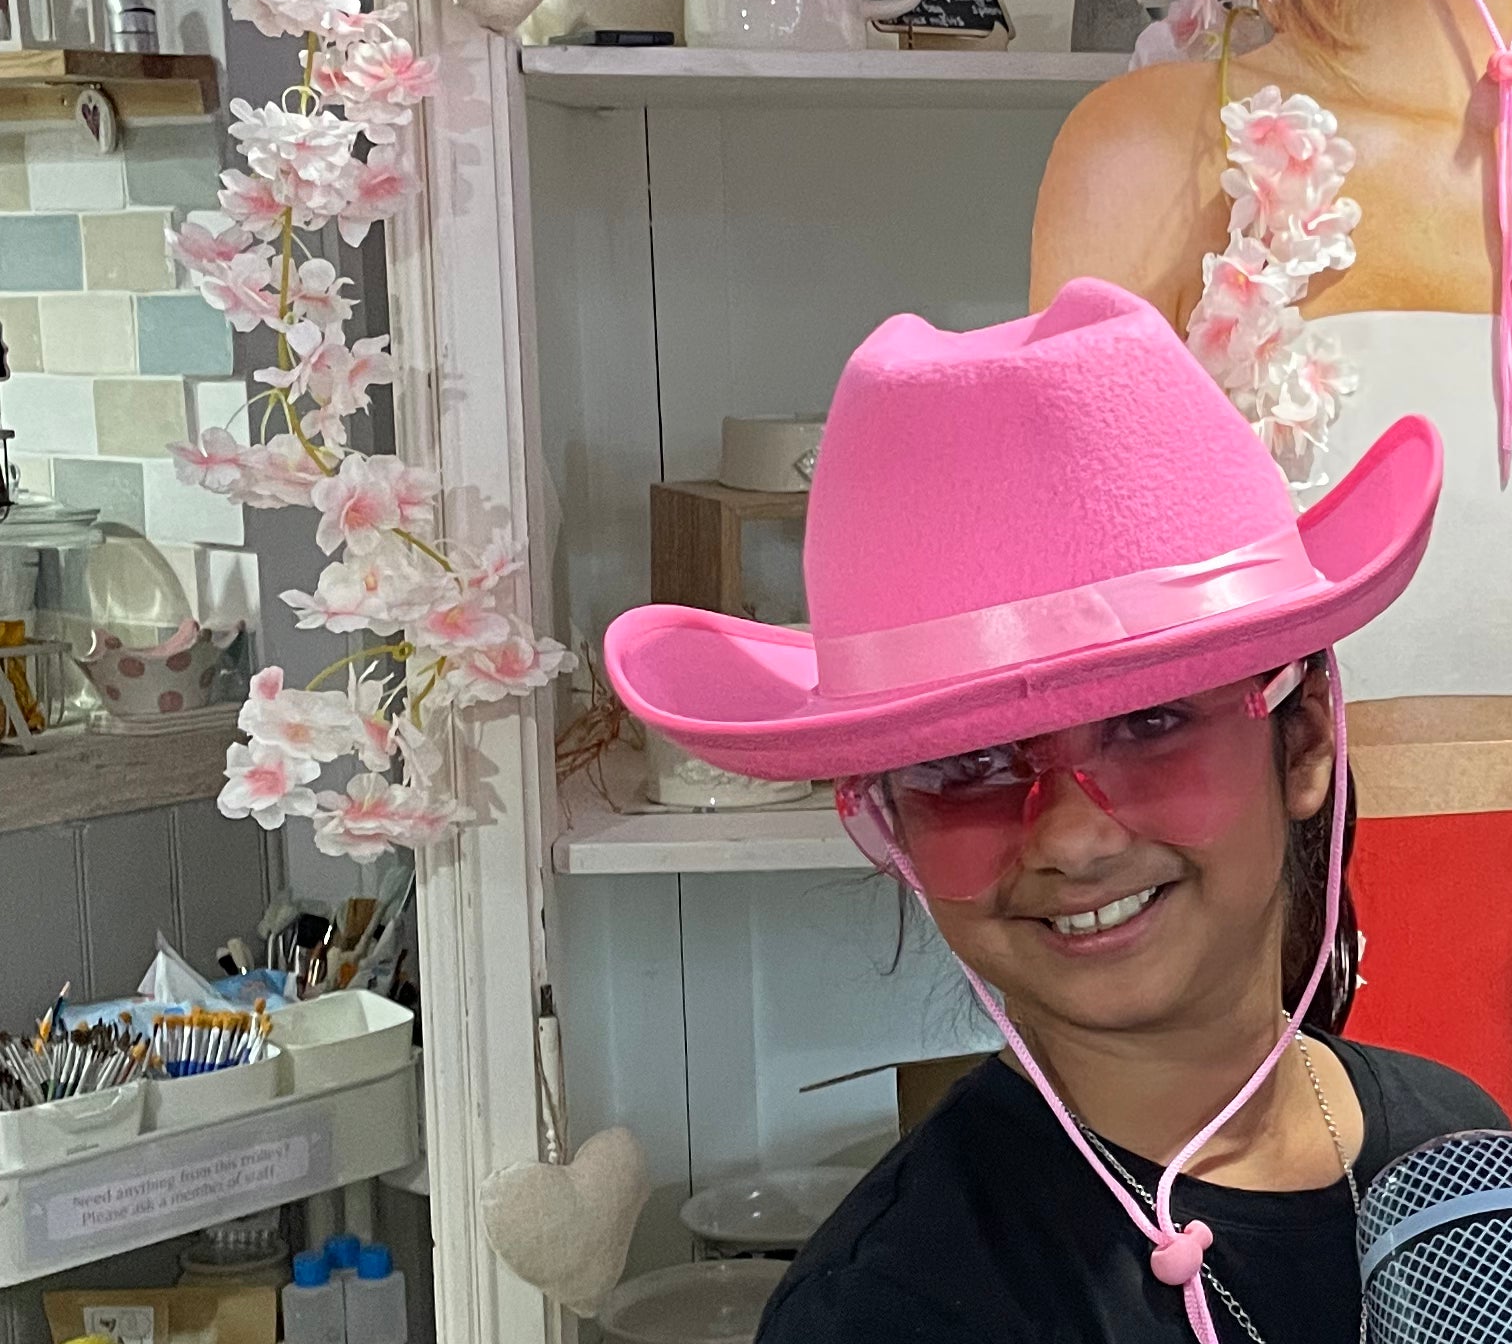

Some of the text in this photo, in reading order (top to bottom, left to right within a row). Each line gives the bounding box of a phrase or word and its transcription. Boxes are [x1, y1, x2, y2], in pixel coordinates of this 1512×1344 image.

[82, 1164, 276, 1227] Please ask a member of staff
[116, 1175, 177, 1200] anything
[180, 1164, 212, 1183] from
[214, 1159, 238, 1179] this
